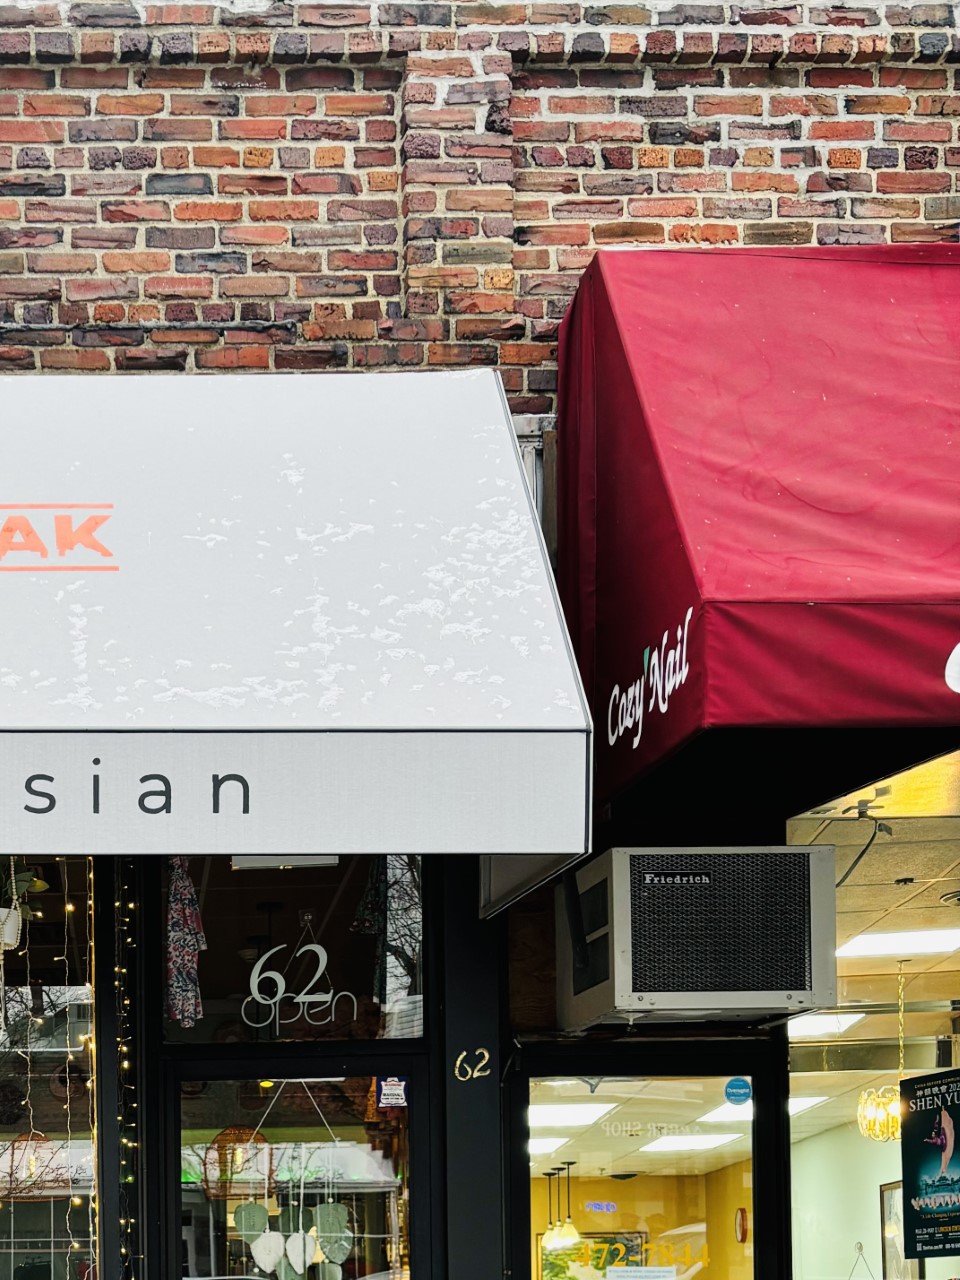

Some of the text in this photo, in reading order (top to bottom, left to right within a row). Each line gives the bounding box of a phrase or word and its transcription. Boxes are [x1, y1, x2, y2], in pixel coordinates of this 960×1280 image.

[649, 606, 693, 714] Nail
[644, 874, 710, 884] Friedrich
[250, 944, 333, 1005] 62
[241, 992, 357, 1036] open
[455, 1048, 490, 1081] 62
[909, 1095, 942, 1112] SHEN
[576, 1243, 711, 1268] 472-7844
